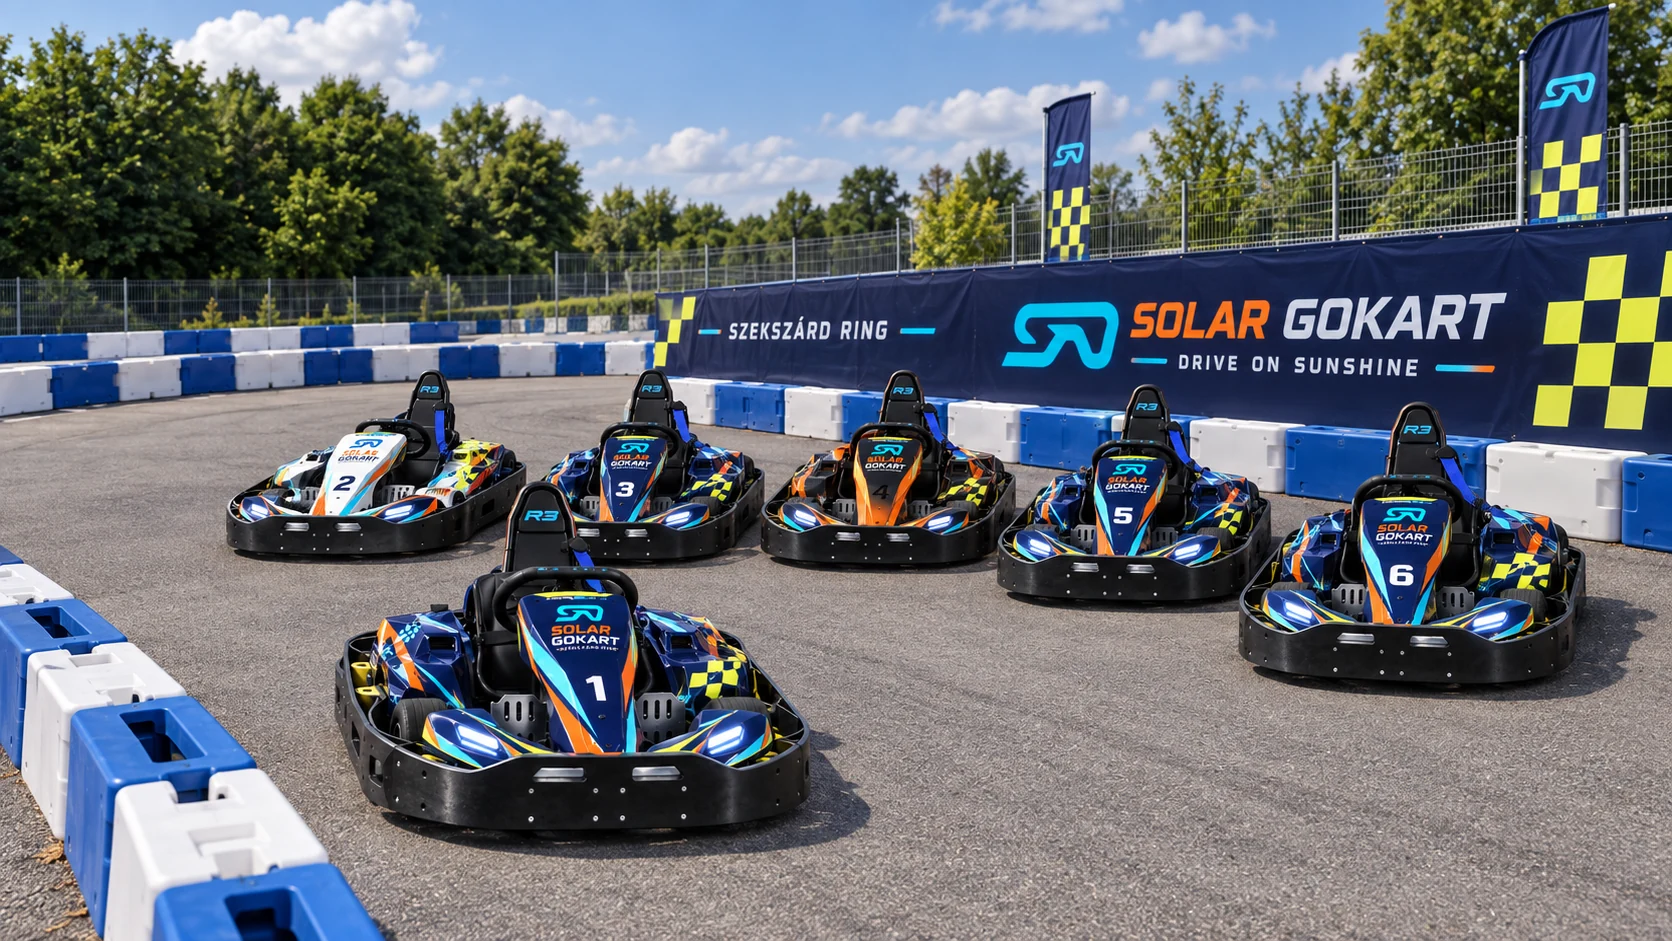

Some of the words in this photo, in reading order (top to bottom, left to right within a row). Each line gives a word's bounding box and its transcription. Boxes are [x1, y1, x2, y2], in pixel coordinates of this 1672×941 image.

[1129, 299, 1271, 340] SOLAR
[1283, 292, 1508, 341] GOKART
[728, 316, 831, 341] SZEKSZÁRD
[840, 320, 888, 341] RING
[1178, 354, 1238, 372] DRIVE
[1251, 355, 1280, 373] ON
[1293, 356, 1420, 377] SUNSHINE
[420, 385, 440, 393] R3
[641, 385, 663, 393] R3
[892, 386, 914, 395] R3
[1135, 402, 1159, 411] R3
[1403, 425, 1432, 435] R3
[333, 475, 356, 491] 2
[615, 481, 635, 498] 3
[872, 484, 890, 500] 4
[524, 510, 560, 522] R3
[1112, 506, 1134, 525] 5
[1376, 523, 1429, 533] SOLAR
[1375, 532, 1434, 542] GOKART
[1389, 564, 1415, 587] 6
[551, 624, 612, 636] SOLAR
[551, 635, 620, 647] GOKART
[585, 675, 607, 702] 1
